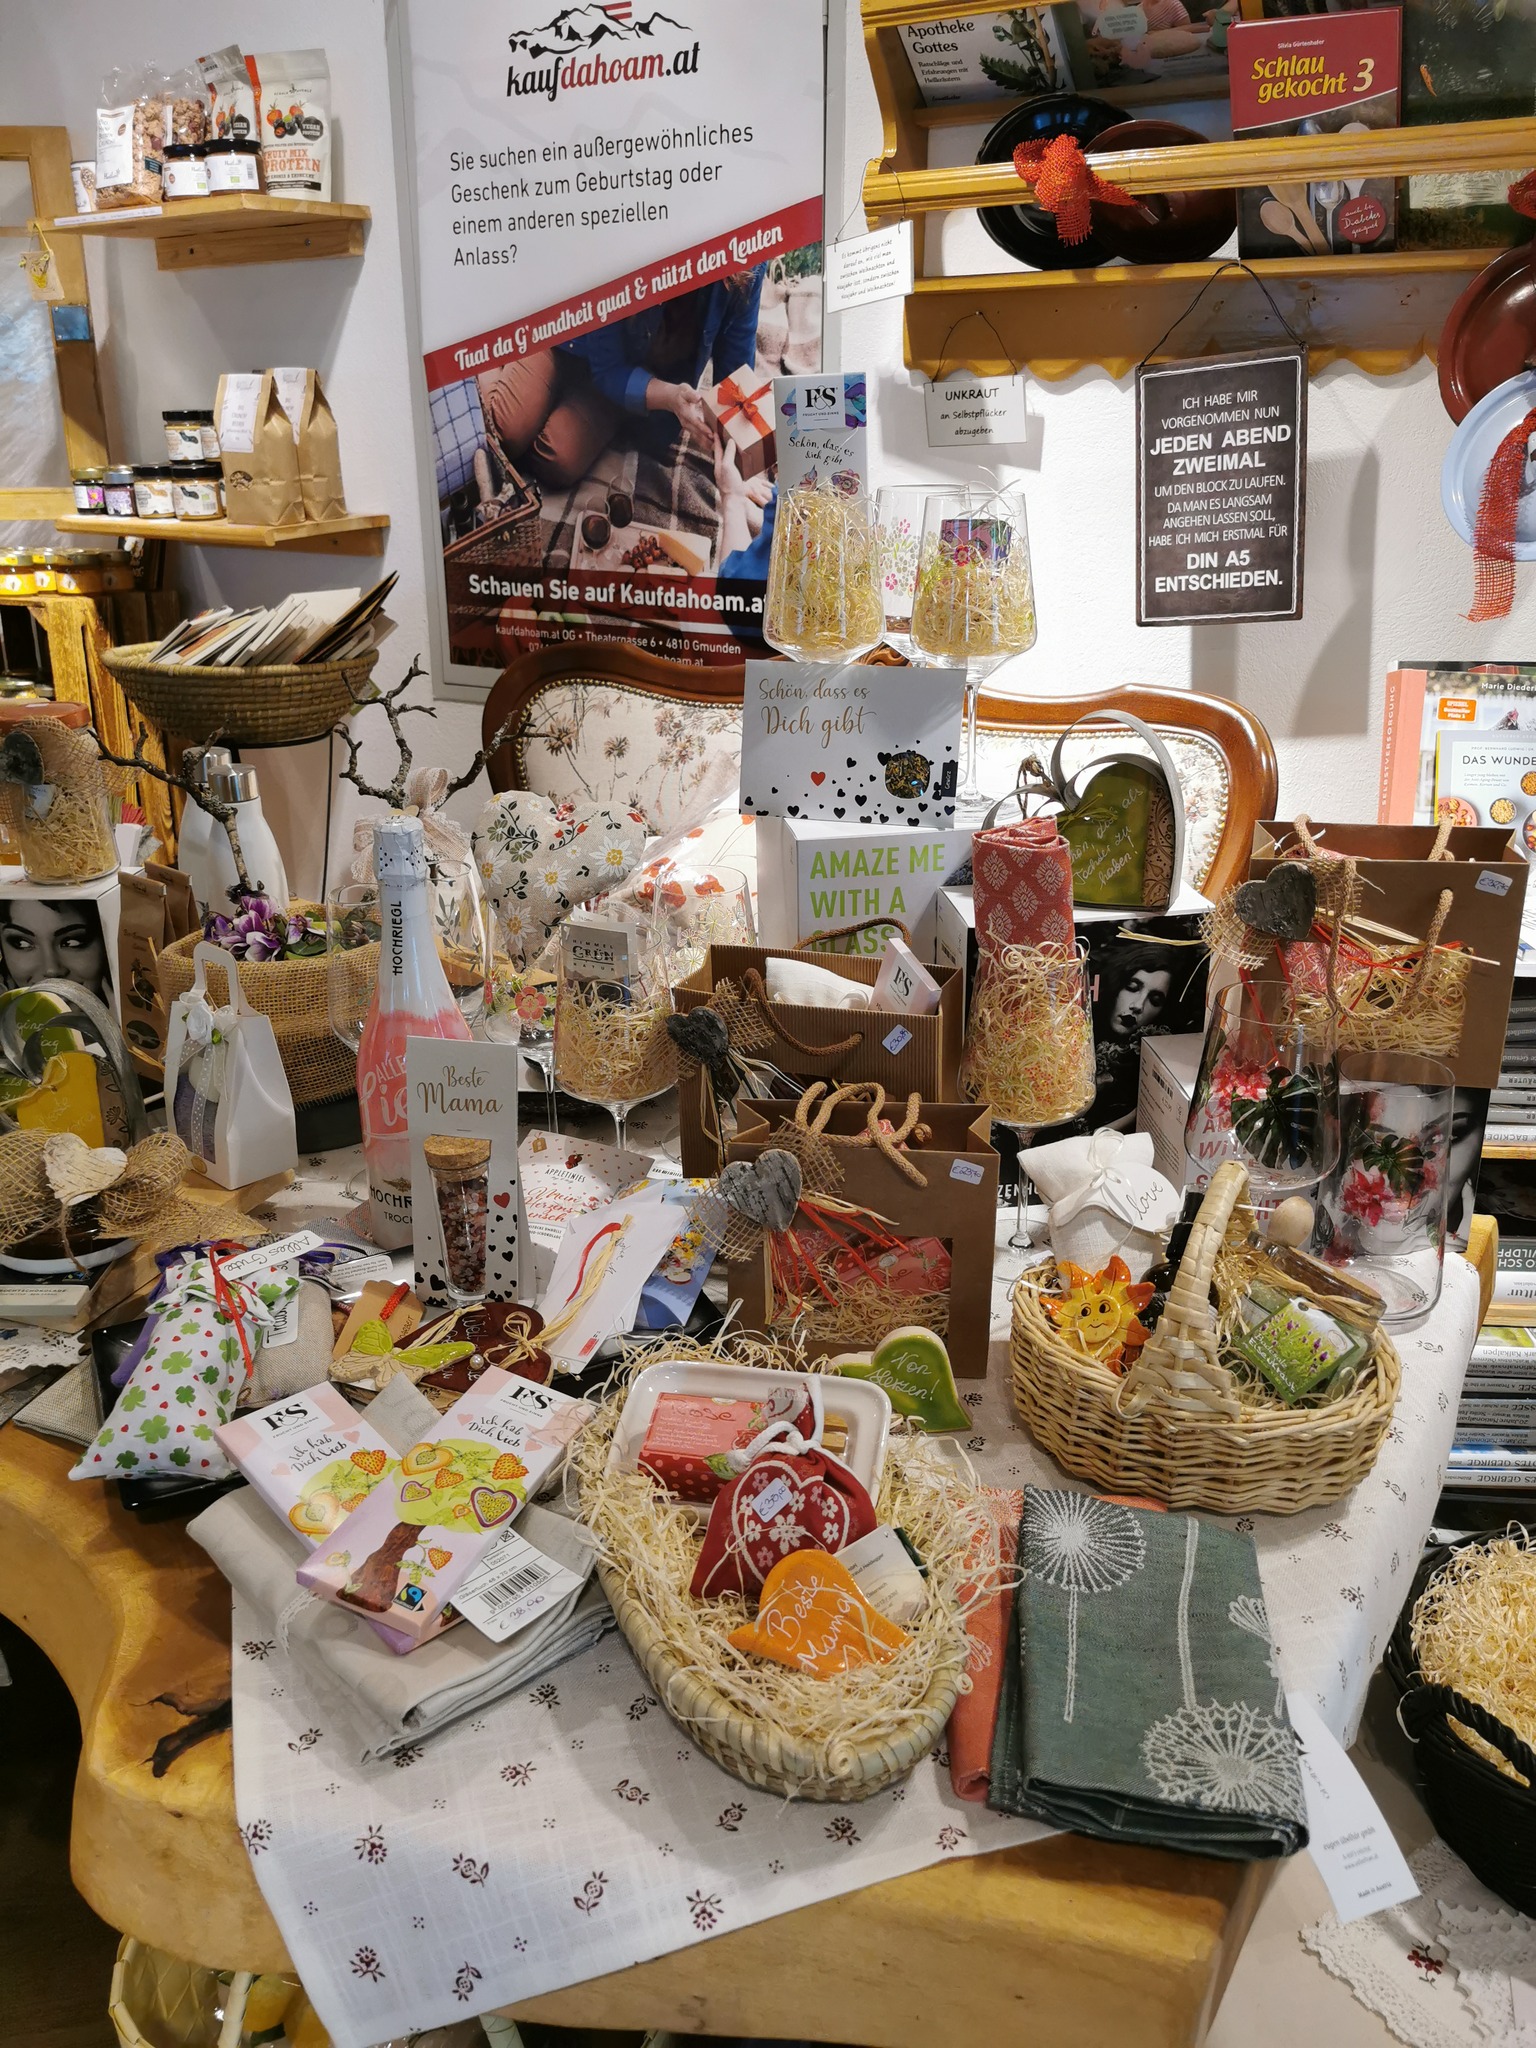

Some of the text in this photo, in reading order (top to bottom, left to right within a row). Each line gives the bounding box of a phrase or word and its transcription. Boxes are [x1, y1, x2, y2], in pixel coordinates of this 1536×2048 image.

[907, 18, 976, 40] Apotheke
[912, 41, 959, 55] Gottes
[506, 41, 701, 102] kaufdahoam.at
[951, 58, 964, 66] und
[1251, 54, 1325, 81] Schlau
[1258, 57, 1376, 104] gekocht 3
[450, 123, 754, 173] Sie suchen ein außergewöhnliches
[264, 159, 321, 173] PROTEIN
[451, 161, 722, 205] Geschenk zum Geburtstag oder
[453, 202, 669, 236] einem anderen speziellen
[453, 244, 518, 268] Anlass?
[846, 243, 881, 258] kommt übrigens
[882, 250, 892, 258] man
[839, 258, 895, 280] zwischen und
[862, 269, 900, 284] sondern zwischen
[453, 346, 490, 372] Tuat
[492, 336, 514, 360] da
[596, 284, 631, 323] guat
[634, 276, 649, 301] &
[651, 257, 694, 294] nützt
[696, 249, 728, 277] den
[729, 225, 784, 265] Leuten
[945, 387, 1000, 402] UNKRAUT
[1182, 389, 1259, 410] ICH HABE MIR
[940, 408, 1007, 421] an Selbstpflücker
[1161, 405, 1280, 430] VORGENOMMEN NUN
[788, 436, 820, 450] Schön,
[954, 425, 995, 438] abzugeben
[1150, 424, 1292, 456] JEDEN ABEND
[1172, 450, 1266, 476] ZWEIMAL
[1154, 474, 1286, 498] UM DEN BLOCK ZU LAUFEN.
[1167, 493, 1272, 514] DA MAN ES LANGSAM
[1162, 509, 1276, 530] ANGEHEN LASSEN SOLL,
[1149, 523, 1288, 547] HABE ICH MICH ERSTMAL FÜR
[1186, 550, 1250, 570] DIN A5
[468, 573, 545, 600] Schauen
[549, 579, 580, 601] Sie
[584, 581, 616, 603] auf
[1155, 569, 1283, 593] ENTSCHIEDEN.
[495, 622, 561, 641] kaufdahoam.at
[561, 628, 576, 642] OG
[650, 634, 657, 649] 6
[665, 638, 691, 652] 4810
[692, 639, 742, 656] Gmunden
[758, 677, 871, 701] Schön, dass es
[1481, 682, 1505, 691] Marie
[760, 704, 877, 749] Dich gibt
[1381, 685, 1397, 806] SELBSTVERSORGUNG
[1462, 755, 1487, 765] DAS
[809, 843, 946, 880] AMAZE ME
[809, 886, 907, 919] WITH A
[390, 900, 403, 976] HOCHRIEGL
[572, 938, 614, 950] HIMMEL
[571, 944, 615, 963] GRÜN
[572, 961, 615, 973] NATUR
[442, 1065, 490, 1089] Beste
[416, 1081, 504, 1116] Mama
[544, 1167, 587, 1184] APPLETINIES
[1127, 1180, 1164, 1222] love
[268, 1233, 311, 1257] Alles
[889, 1351, 933, 1376] Von
[863, 1366, 941, 1402] Herzen!
[468, 1421, 497, 1438] Dich
[480, 1414, 525, 1436] Ich hab
[306, 1433, 333, 1449] hab
[290, 1451, 323, 1473] Dich
[1466, 1459, 1512, 1468] GEBIRGE
[1477, 1475, 1522, 1485] GEBIRGE
[766, 1572, 827, 1652] Beste
